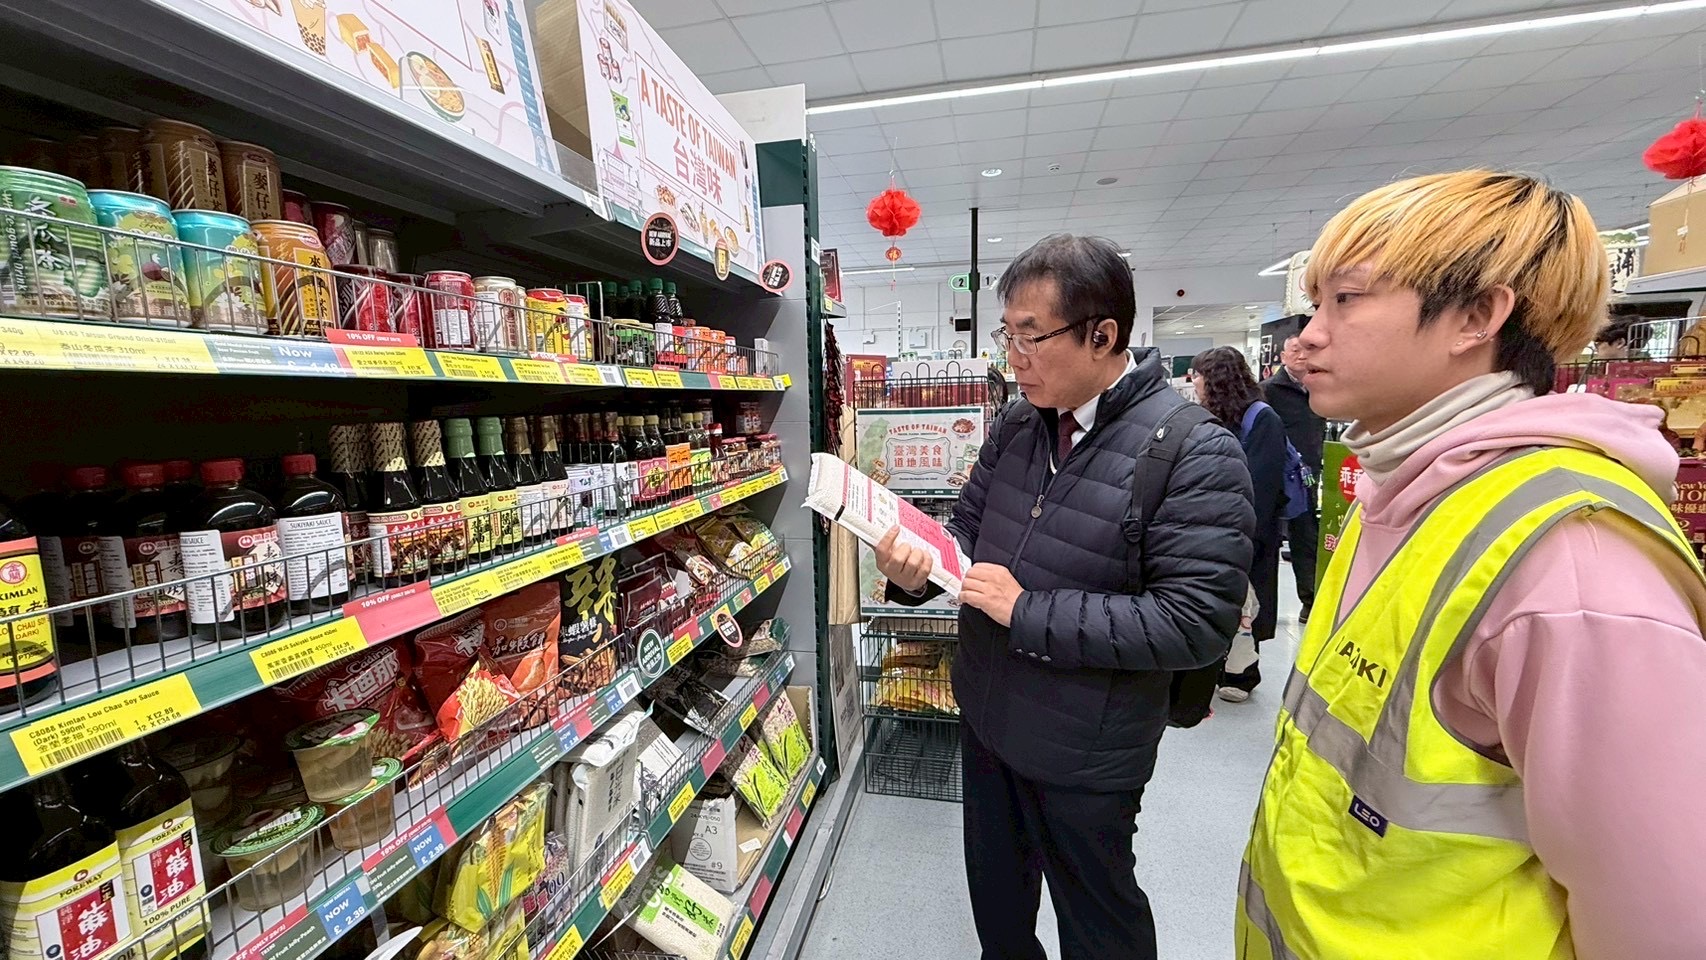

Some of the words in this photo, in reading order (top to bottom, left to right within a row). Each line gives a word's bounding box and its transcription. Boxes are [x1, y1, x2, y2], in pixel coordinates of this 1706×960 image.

[640, 67, 650, 107] A
[652, 77, 686, 138] TASTE
[688, 113, 700, 150] OF
[702, 126, 736, 180] TAIWAN
[673, 136, 722, 205] 台灣味
[958, 278, 964, 287] 2
[985, 276, 990, 285] 1
[278, 346, 312, 358] Now
[889, 425, 909, 434] TASTE
[922, 424, 947, 434] TAIWAN
[894, 444, 942, 456] 臺灣美食
[894, 457, 942, 467] 道地風味
[361, 598, 376, 608] 10%
[377, 594, 390, 604] OFF
[17, 620, 36, 632] CHAU
[289, 639, 309, 650] Sukiyaki
[324, 628, 338, 636] 450ml
[315, 642, 332, 651] 450ml
[643, 639, 654, 653] NEW
[349, 647, 390, 673] Cadina
[642, 645, 660, 665] ARRIVAL
[327, 654, 399, 710] 卡迪那
[29, 725, 56, 739] C8088
[58, 716, 86, 729] Kimlan
[87, 710, 103, 720] Lou
[103, 703, 123, 713] Chau
[123, 697, 138, 706] Soy
[138, 690, 160, 700] Sauce
[153, 706, 174, 720] £2.89
[157, 712, 182, 726] £34.68
[33, 733, 59, 746] (Dark)
[60, 724, 85, 737] 590ml
[37, 732, 84, 753] 金蘭老抽
[86, 720, 117, 736] 590ml
[1354, 803, 1380, 828] LEO
[151, 823, 184, 843] FOREWAY
[705, 826, 718, 834] A3
[380, 845, 395, 857] 10%
[395, 835, 408, 846] OFF
[414, 835, 432, 853] NOW
[421, 856, 428, 865] £
[429, 843, 444, 859] 2.39
[60, 872, 102, 898] FOREWAY
[323, 899, 334, 908] NEW
[334, 886, 351, 900] ARRIVAL
[143, 910, 169, 926] 100%
[170, 895, 191, 912] PURE
[324, 900, 350, 922] NOW
[334, 925, 342, 935] £
[345, 906, 365, 926] 2.39
[236, 950, 248, 960] FF
[250, 937, 269, 954] (ONLY
[275, 945, 289, 958] Fruit
